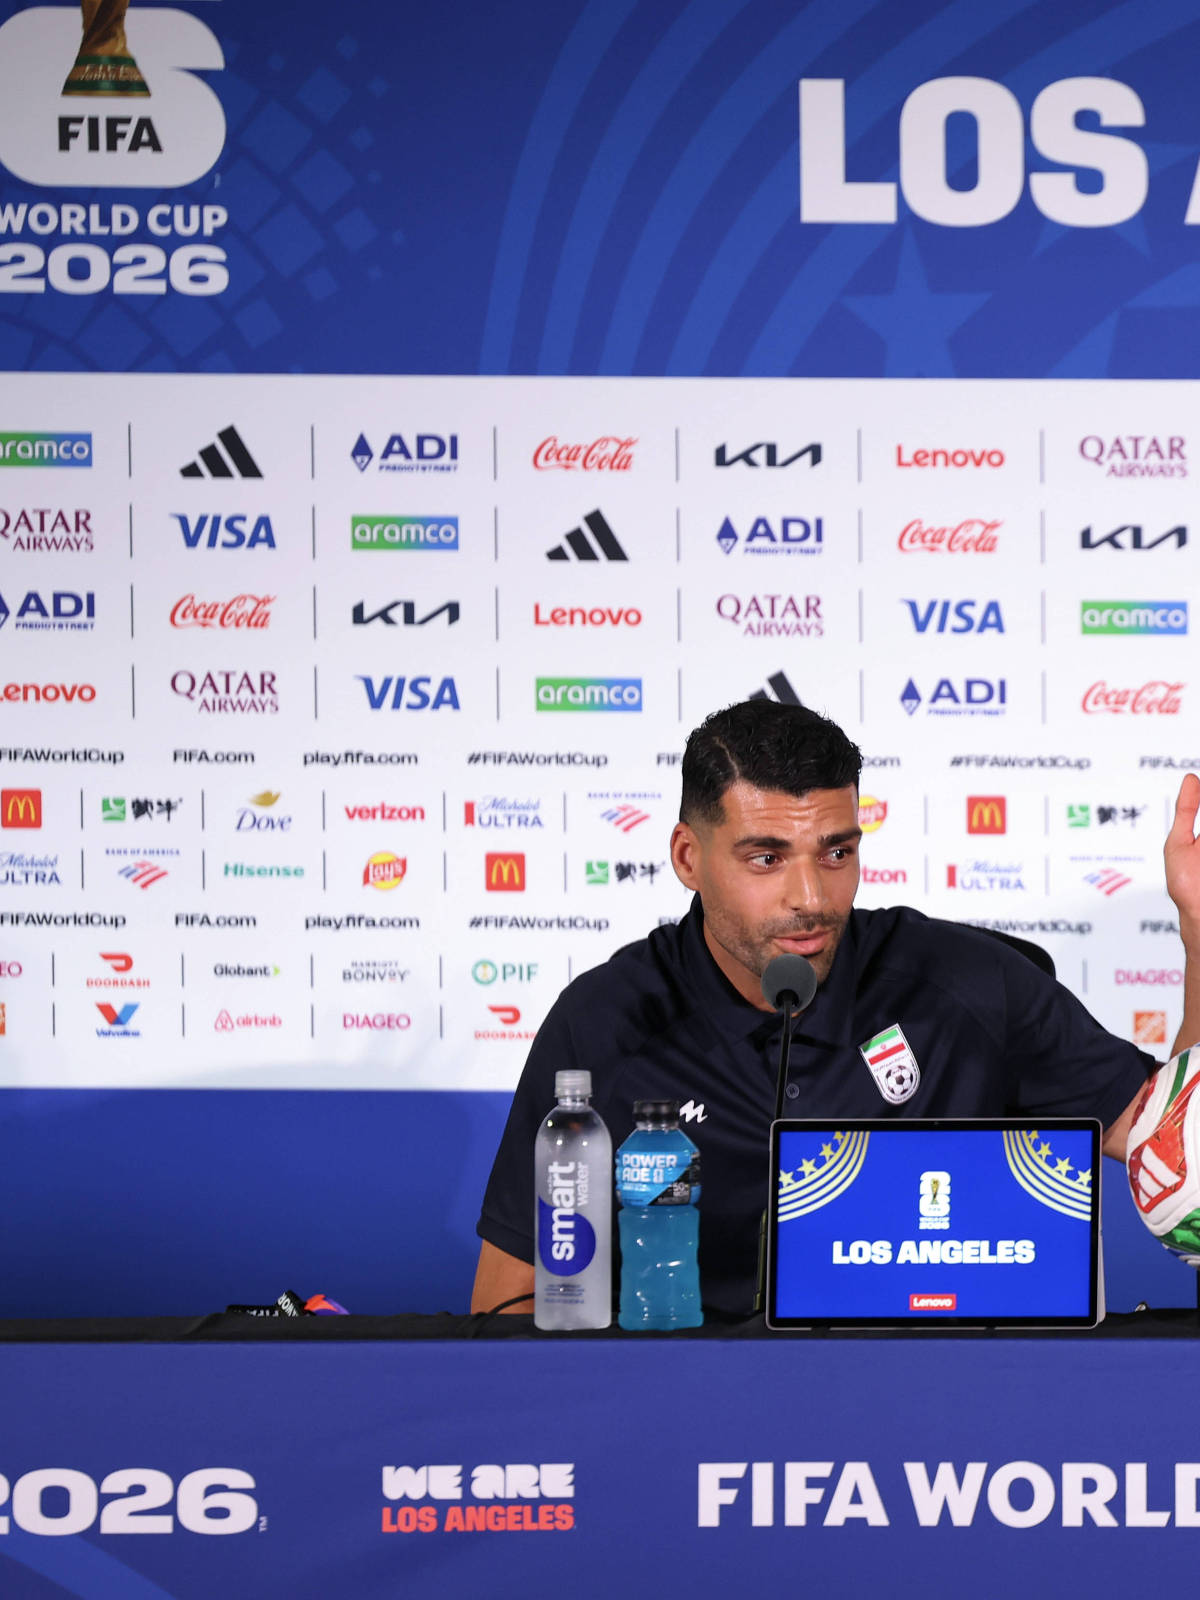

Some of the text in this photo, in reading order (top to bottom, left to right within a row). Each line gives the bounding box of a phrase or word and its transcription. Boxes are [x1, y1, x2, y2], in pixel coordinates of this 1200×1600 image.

[58, 116, 163, 152] FIFA
[799, 76, 1148, 228] LOS
[0, 203, 228, 236] WORLD CUP
[0, 243, 229, 296] 2026
[0, 441, 90, 459] ramco
[380, 434, 458, 460] ADI
[533, 437, 637, 470] Coca-Cola
[897, 445, 1005, 468] Lenovo
[1079, 436, 1186, 463] QATAR
[1108, 463, 1187, 478] AIRWAYS
[173, 514, 276, 549] VISA
[354, 523, 457, 544] aramco
[746, 517, 822, 543] ADI
[13, 536, 94, 553] AIRWAYS
[17, 592, 95, 618] ADI
[170, 595, 273, 628] Coca-Cola
[534, 603, 642, 626] Lenovo
[716, 594, 822, 622] QATAR
[904, 600, 1005, 634] VISA
[1083, 608, 1186, 629] aramco
[743, 621, 823, 638] AIRWAYS
[0, 683, 96, 702] enovo
[171, 671, 276, 699] QATAR
[360, 677, 460, 710] VISA
[538, 685, 640, 706] aramco
[930, 679, 1006, 704] ADI
[199, 698, 278, 714] AIRWAYS
[173, 750, 254, 762] FIFA.com
[304, 751, 418, 766] play.fifa.com
[468, 752, 608, 768] #FIFAWorldCup
[950, 755, 1091, 770] #FIFAWorldCup
[236, 808, 292, 832] Dove
[345, 802, 425, 821] verizon
[478, 813, 544, 829] ULTRA
[224, 864, 304, 877] Hisense
[861, 867, 907, 884] izon
[960, 877, 1026, 892] ULTRA
[0, 913, 126, 928] FIFAWorldCup
[175, 914, 256, 926] FIFA.com
[305, 915, 419, 930] play.fifa.com
[469, 916, 609, 932] #FIFAWorldCup
[213, 963, 270, 977] Globant
[502, 964, 537, 982] PIF
[1114, 969, 1184, 985] DIAGEO
[236, 1014, 282, 1028] airbnb
[343, 1014, 411, 1030] DIAGEO
[622, 1154, 677, 1167] POWER
[576, 1162, 589, 1206] water
[622, 1168, 650, 1182] ADE
[548, 1161, 576, 1262] smart
[832, 1240, 1035, 1264] LOS ANGELES
[913, 1296, 952, 1307] Lenovo
[382, 1464, 574, 1500] WE ARE
[0, 1468, 257, 1535] 026
[698, 1462, 889, 1527] FIFA
[382, 1504, 574, 1533] LOS ANGELES
